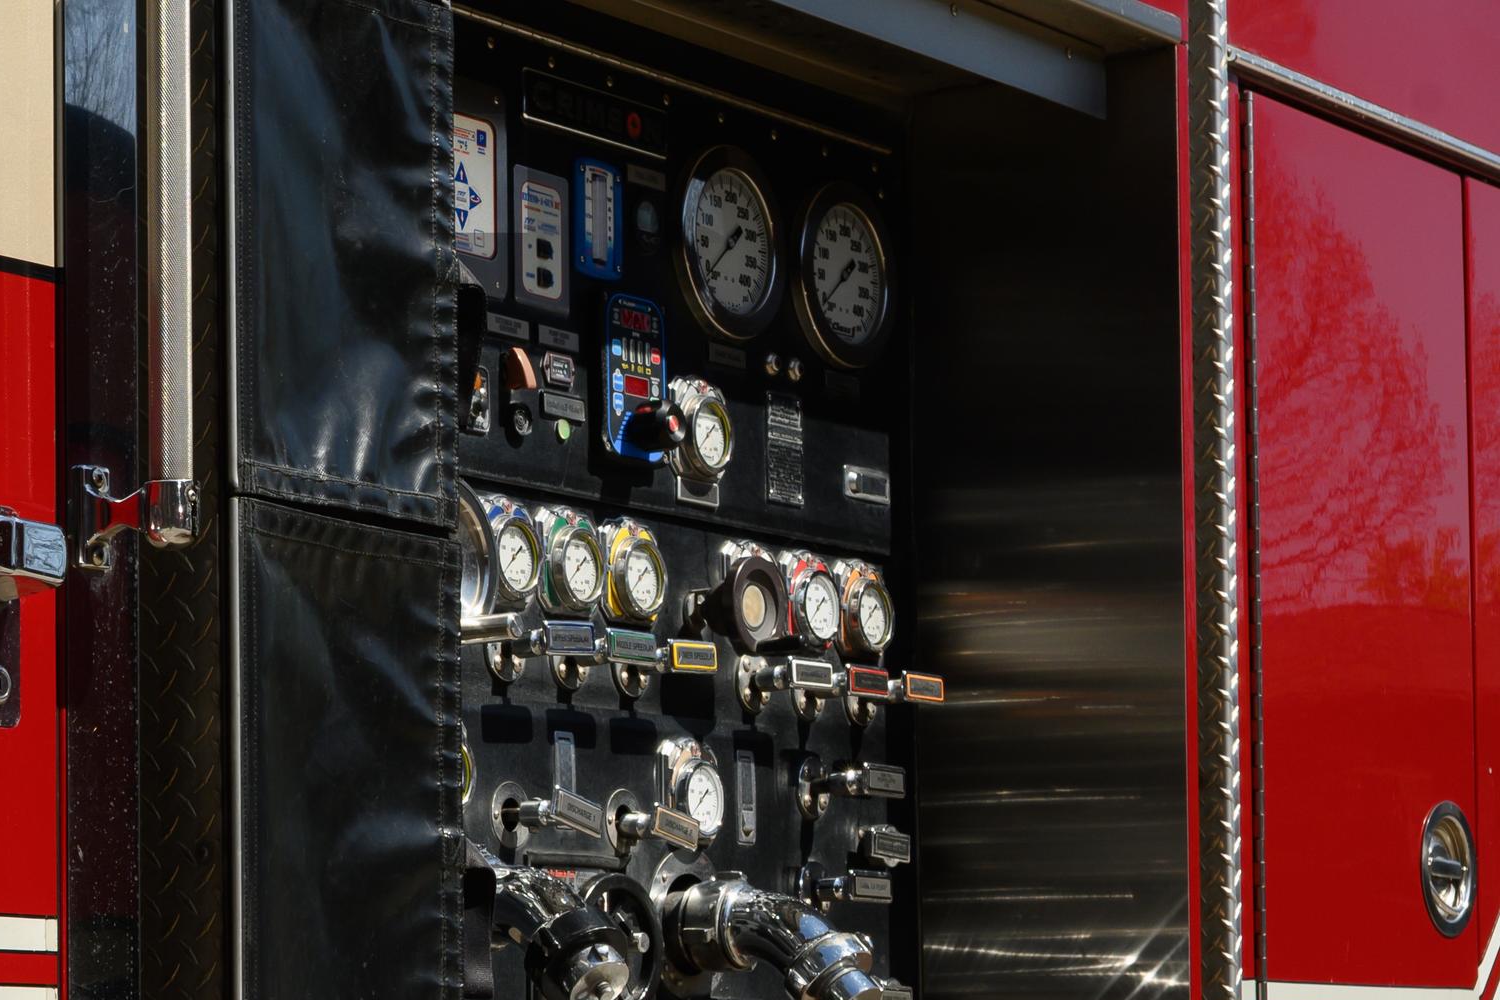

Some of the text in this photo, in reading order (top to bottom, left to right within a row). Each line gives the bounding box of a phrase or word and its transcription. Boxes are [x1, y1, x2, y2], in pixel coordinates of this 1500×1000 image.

[532, 79, 662, 148] CRIMSON
[710, 194, 722, 208] 150
[724, 190, 738, 205] 200
[702, 212, 714, 226] 100
[737, 206, 749, 221] 250
[744, 228, 757, 243] 300
[826, 229, 837, 242] 150
[839, 223, 851, 238] 200
[700, 235, 709, 249] 50
[850, 239, 862, 253] 250
[819, 247, 829, 260] 100
[745, 255, 757, 269] 350
[858, 260, 869, 274] 300
[738, 273, 752, 288] 400
[818, 267, 826, 281] 50
[858, 286, 870, 300] 350
[853, 304, 865, 318] 400
[567, 802, 592, 821] DISCHARGE
[665, 818, 688, 835] DISCHARGE
